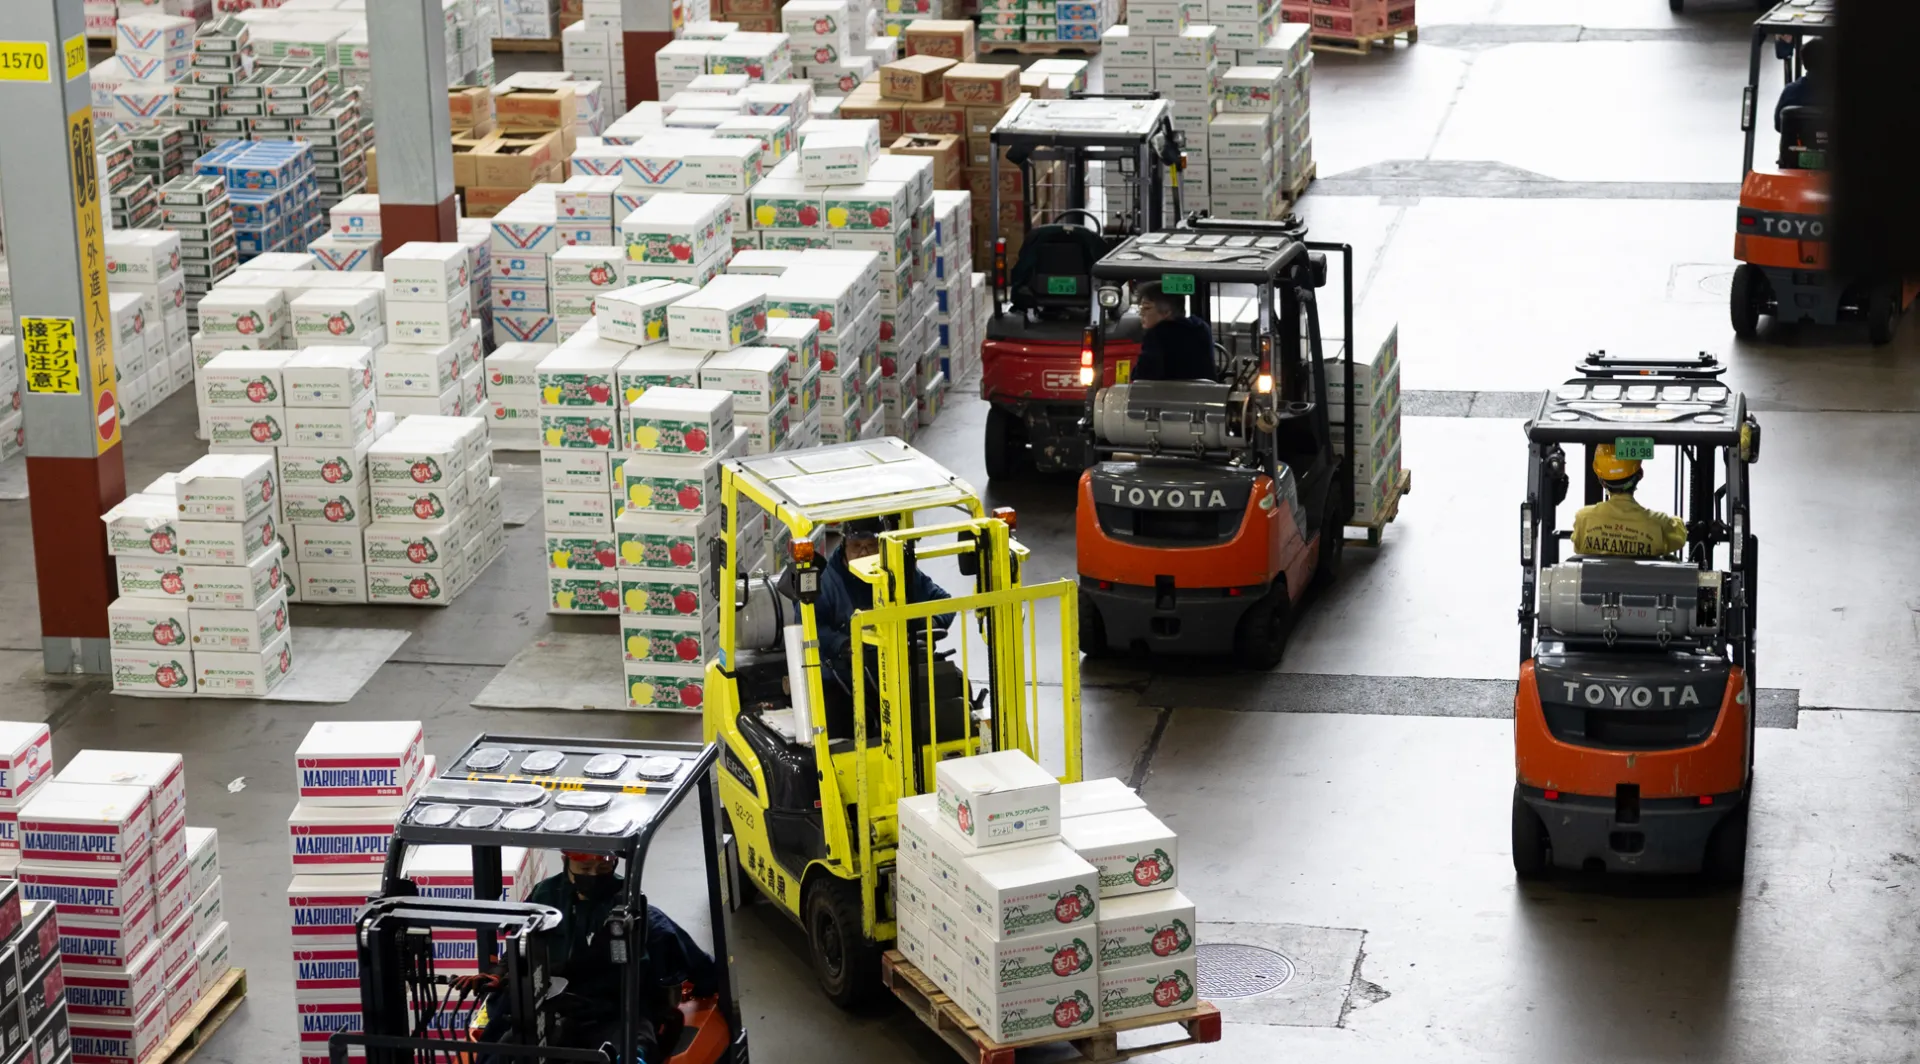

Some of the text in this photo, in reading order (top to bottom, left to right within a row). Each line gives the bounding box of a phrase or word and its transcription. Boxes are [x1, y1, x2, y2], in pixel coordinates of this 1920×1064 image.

[2, 52, 44, 70] 1570
[67, 45, 84, 68] 1570
[84, 208, 109, 387] 以外進入禁止
[27, 321, 53, 388] 接近注意
[48, 322, 72, 388] フォークリフト
[1112, 484, 1226, 508] TOYOTA
[1585, 536, 1652, 555] NAKAMURA
[1563, 681, 1700, 707] TOYOTA
[735, 801, 755, 830] 92-23
